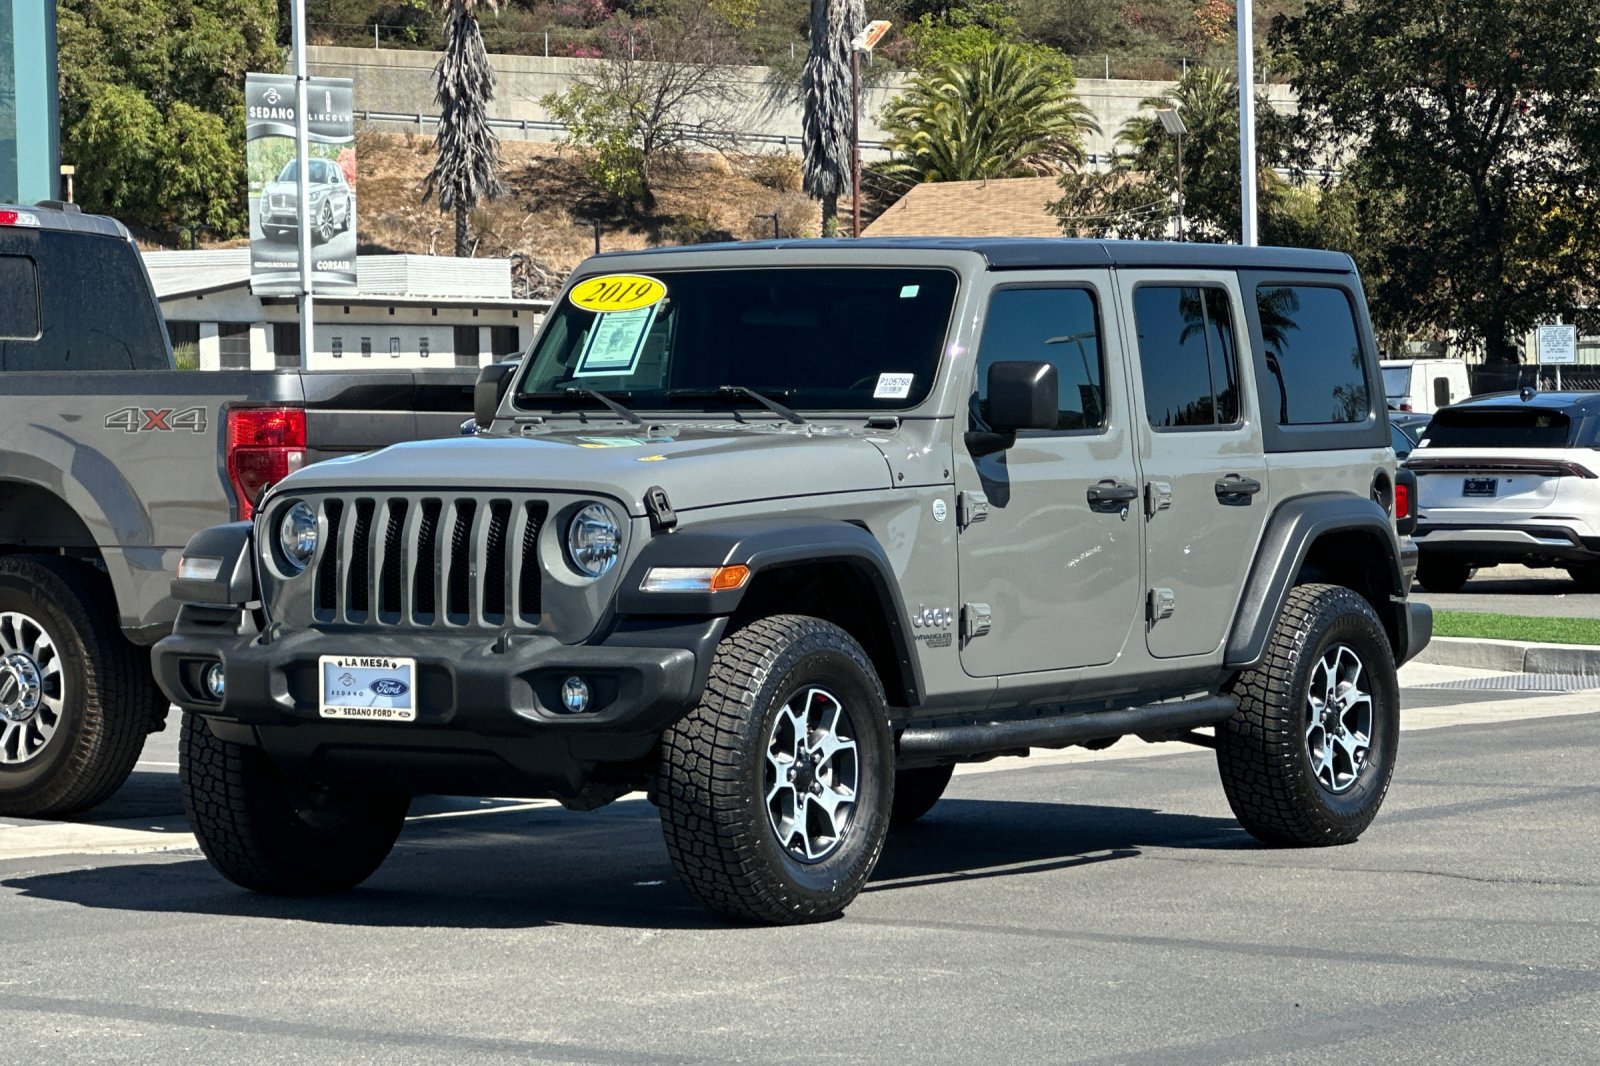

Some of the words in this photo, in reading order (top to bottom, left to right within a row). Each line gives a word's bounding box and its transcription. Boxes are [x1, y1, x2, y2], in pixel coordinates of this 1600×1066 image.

[250, 106, 295, 120] SEDANO
[308, 113, 350, 122] LINCOLN
[316, 260, 350, 271] CORSAIR
[581, 282, 653, 303] 2019
[913, 604, 953, 630] Jeep
[345, 658, 357, 667] LA
[360, 659, 389, 668] MESA
[376, 681, 401, 694] Ford
[343, 708, 371, 716] SEDANO
[373, 709, 391, 717] FORD
